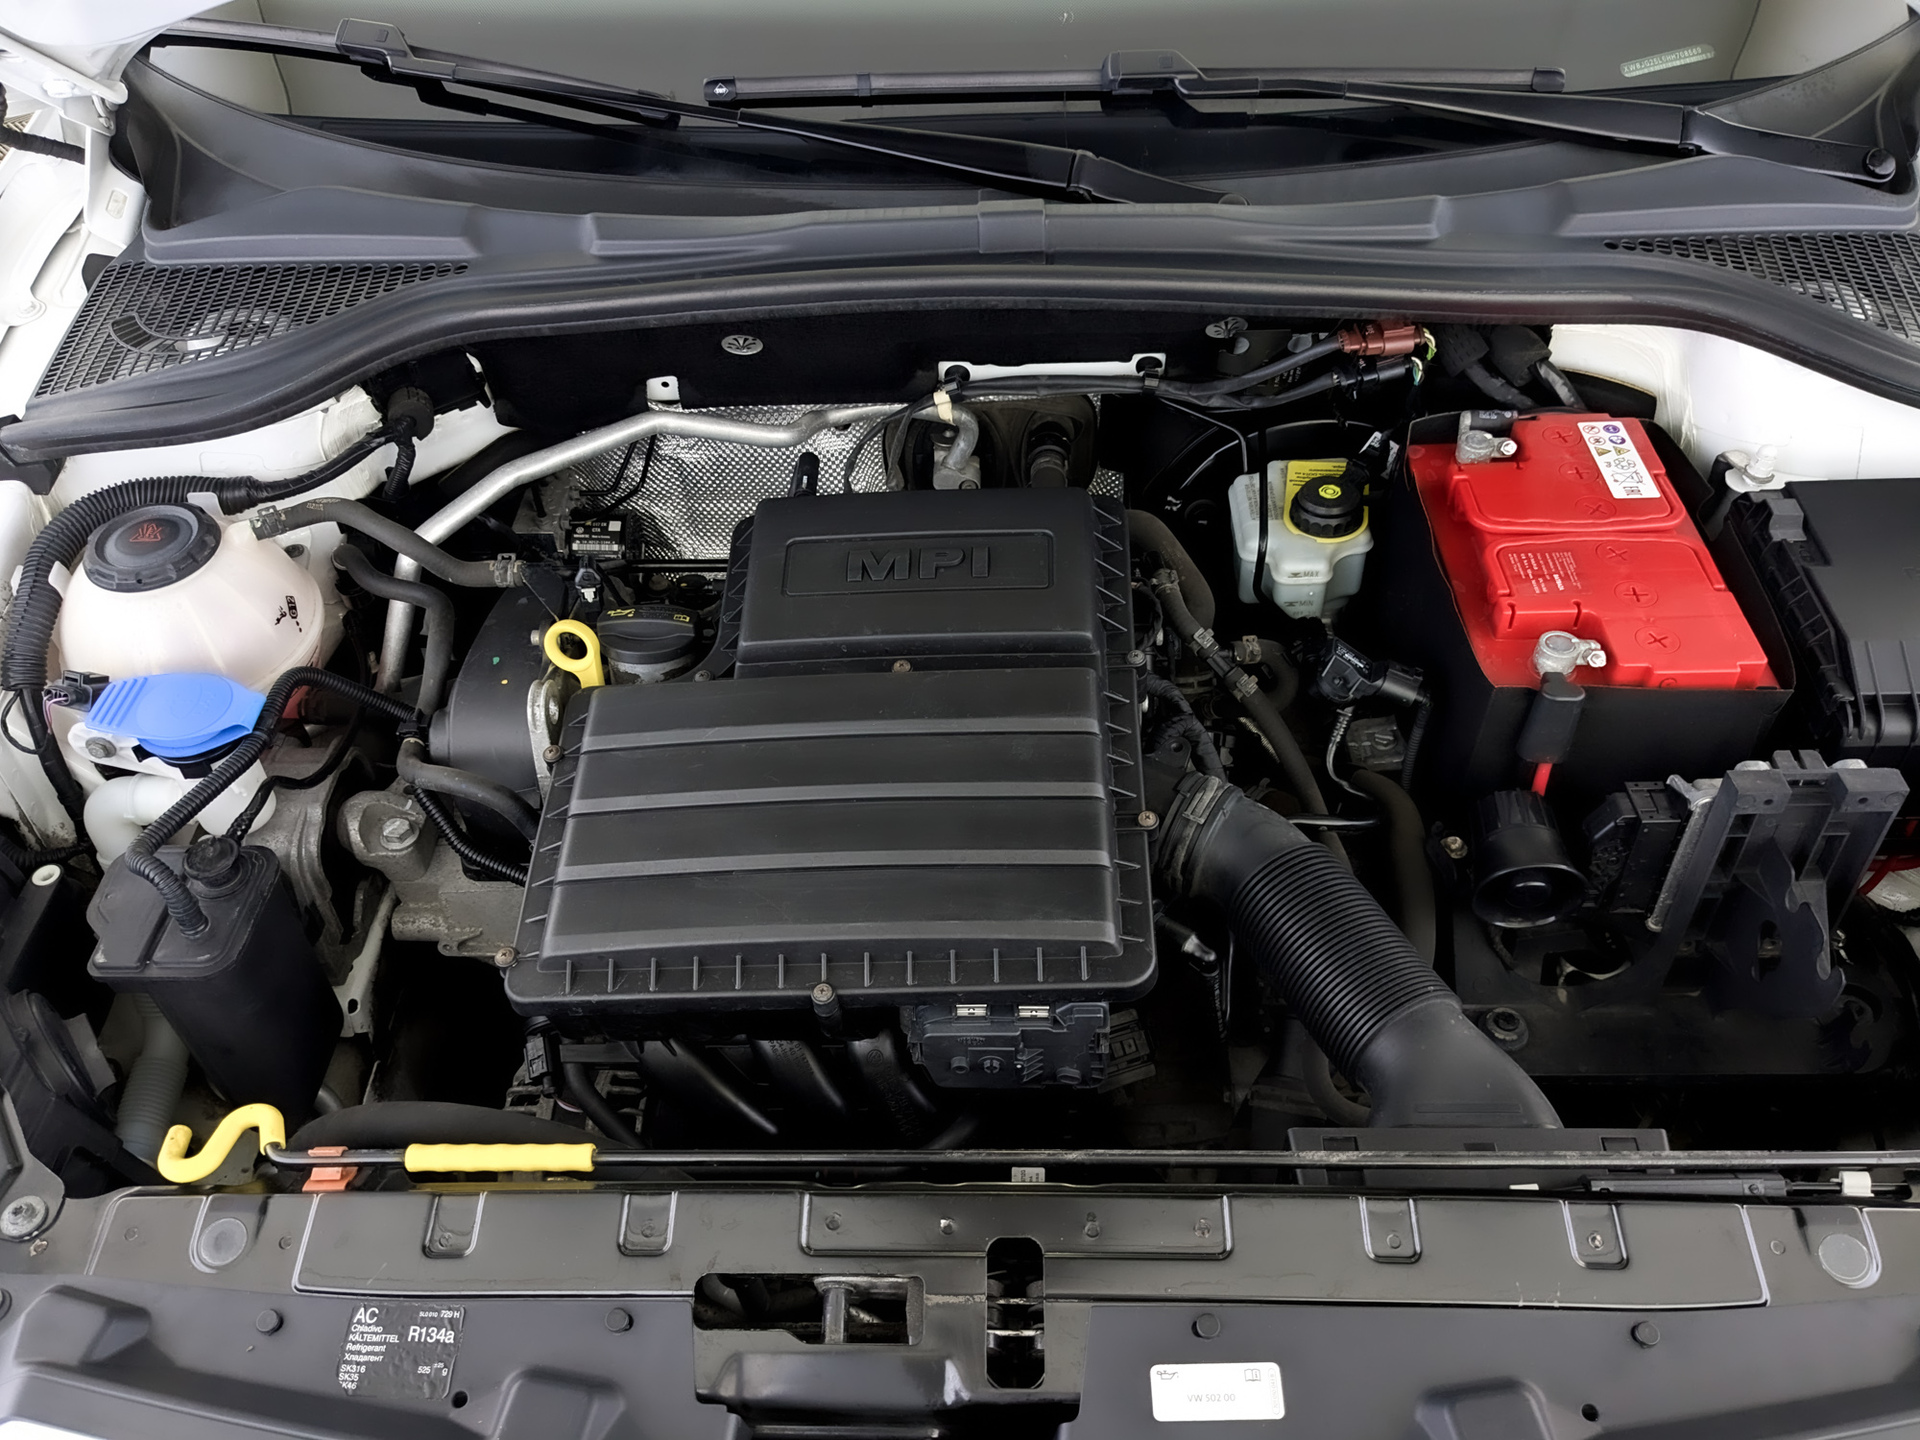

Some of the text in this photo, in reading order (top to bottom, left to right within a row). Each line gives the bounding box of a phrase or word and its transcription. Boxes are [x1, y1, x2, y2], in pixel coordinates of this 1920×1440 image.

[846, 546, 990, 583] MPI
[1303, 570, 1320, 578] MAX
[353, 1307, 379, 1323] AC
[440, 1310, 453, 1318] 729
[453, 1311, 461, 1319] H
[351, 1324, 383, 1333] Chladivo
[408, 1326, 455, 1343] R134a
[345, 1343, 386, 1353] Refrigerant
[340, 1365, 366, 1374] SK316
[417, 1366, 431, 1374] 525
[338, 1373, 359, 1381] SK35
[339, 1381, 357, 1390] K46
[1187, 1393, 1236, 1402] VW 502 00
